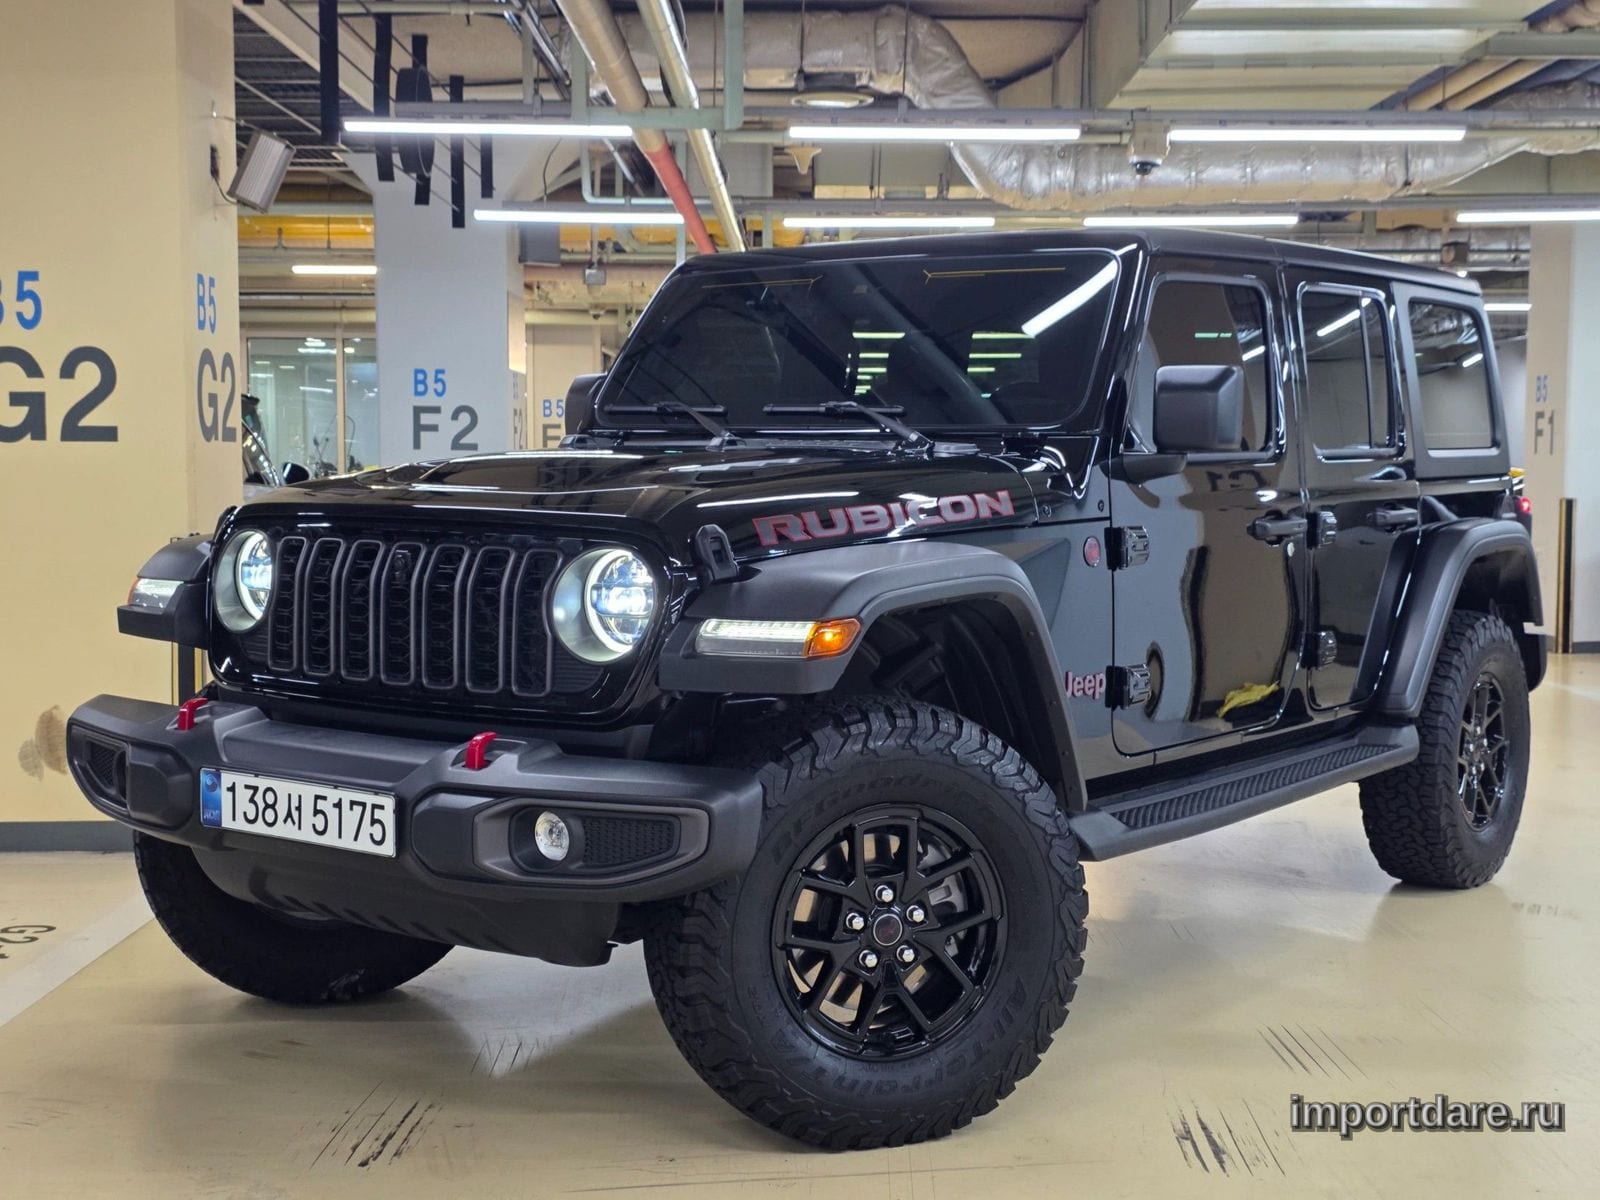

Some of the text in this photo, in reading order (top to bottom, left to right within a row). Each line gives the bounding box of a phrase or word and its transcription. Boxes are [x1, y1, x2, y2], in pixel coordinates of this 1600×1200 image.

[0, 270, 43, 330] 5
[197, 273, 217, 334] B5
[0, 345, 119, 443] G2
[197, 348, 238, 443] G2
[414, 368, 447, 398] B5
[543, 399, 565, 418] B5
[413, 405, 479, 451] F2
[1534, 411, 1554, 455] F1
[752, 490, 1015, 546] RUBICON
[1065, 671, 1106, 700] Jeep
[226, 781, 387, 846] 138서 5175
